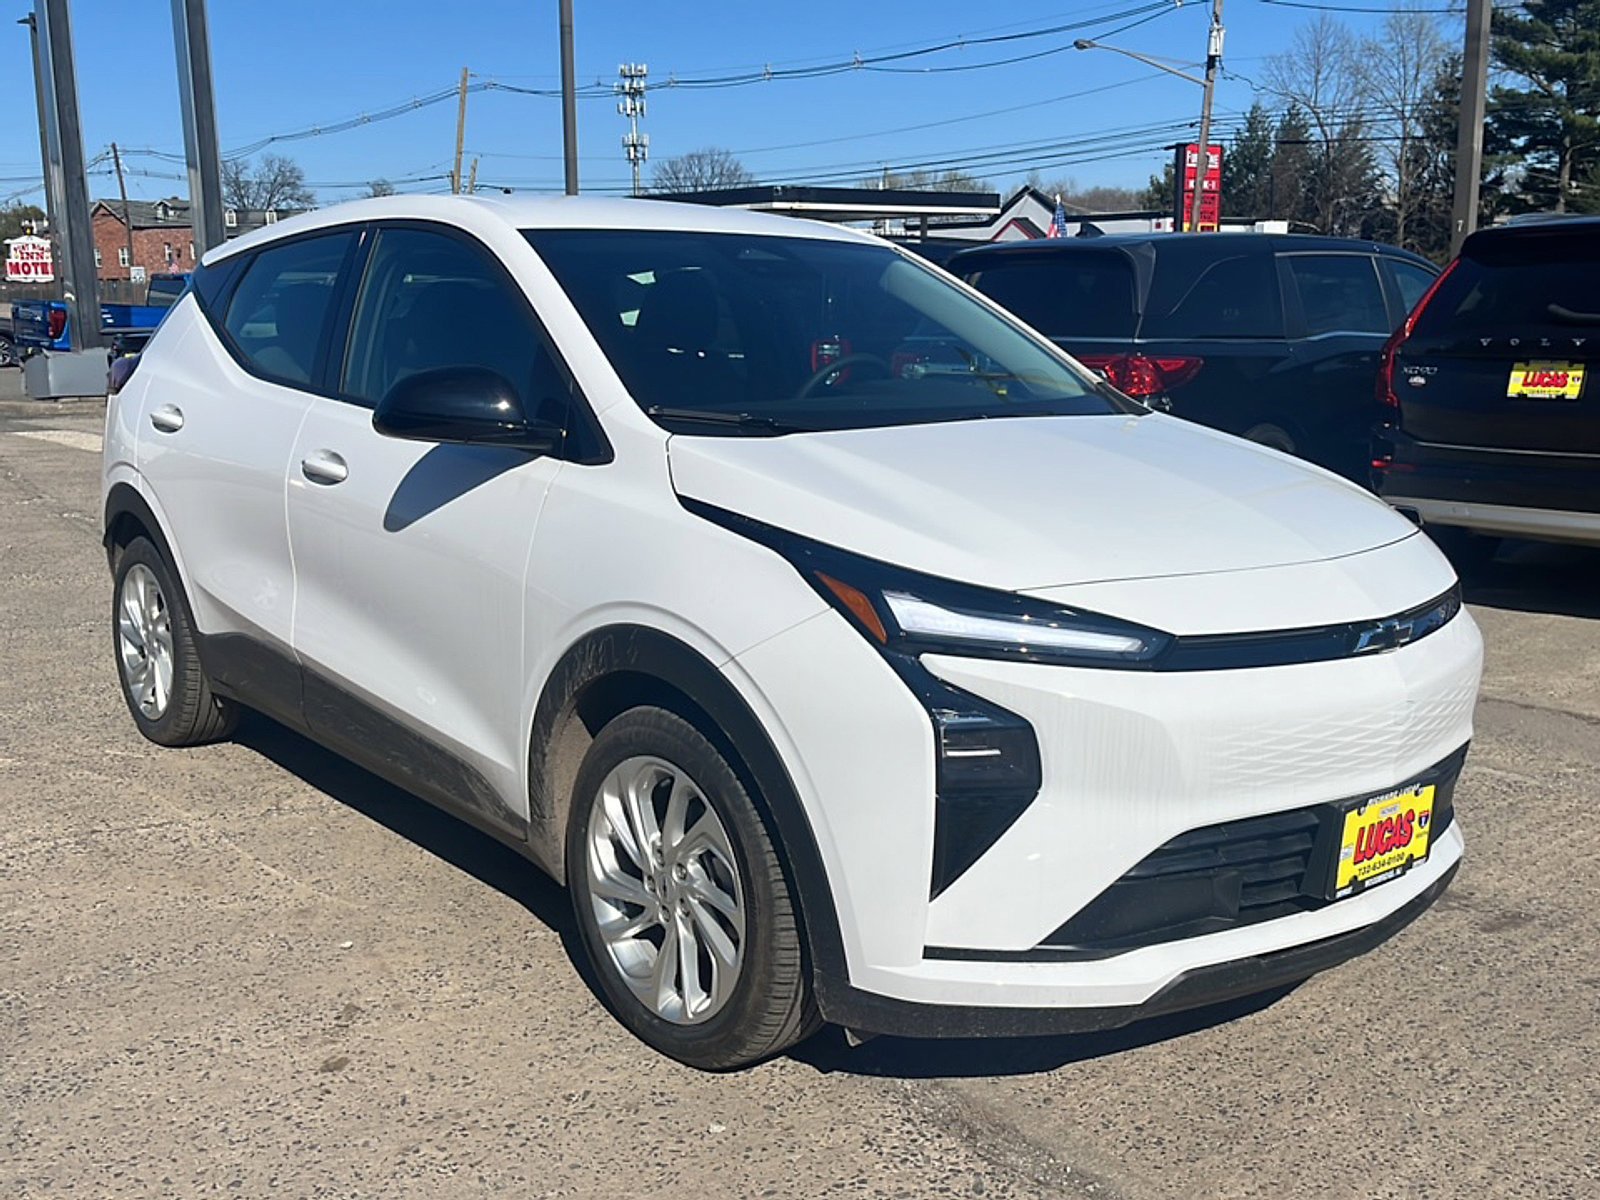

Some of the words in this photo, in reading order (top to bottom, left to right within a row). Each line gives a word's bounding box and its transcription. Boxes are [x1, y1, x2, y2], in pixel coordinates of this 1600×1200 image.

[1457, 219, 1464, 232] 7
[20, 251, 44, 260] INN
[1521, 371, 1569, 388] LUCAS
[1353, 809, 1416, 866] LUCAS
